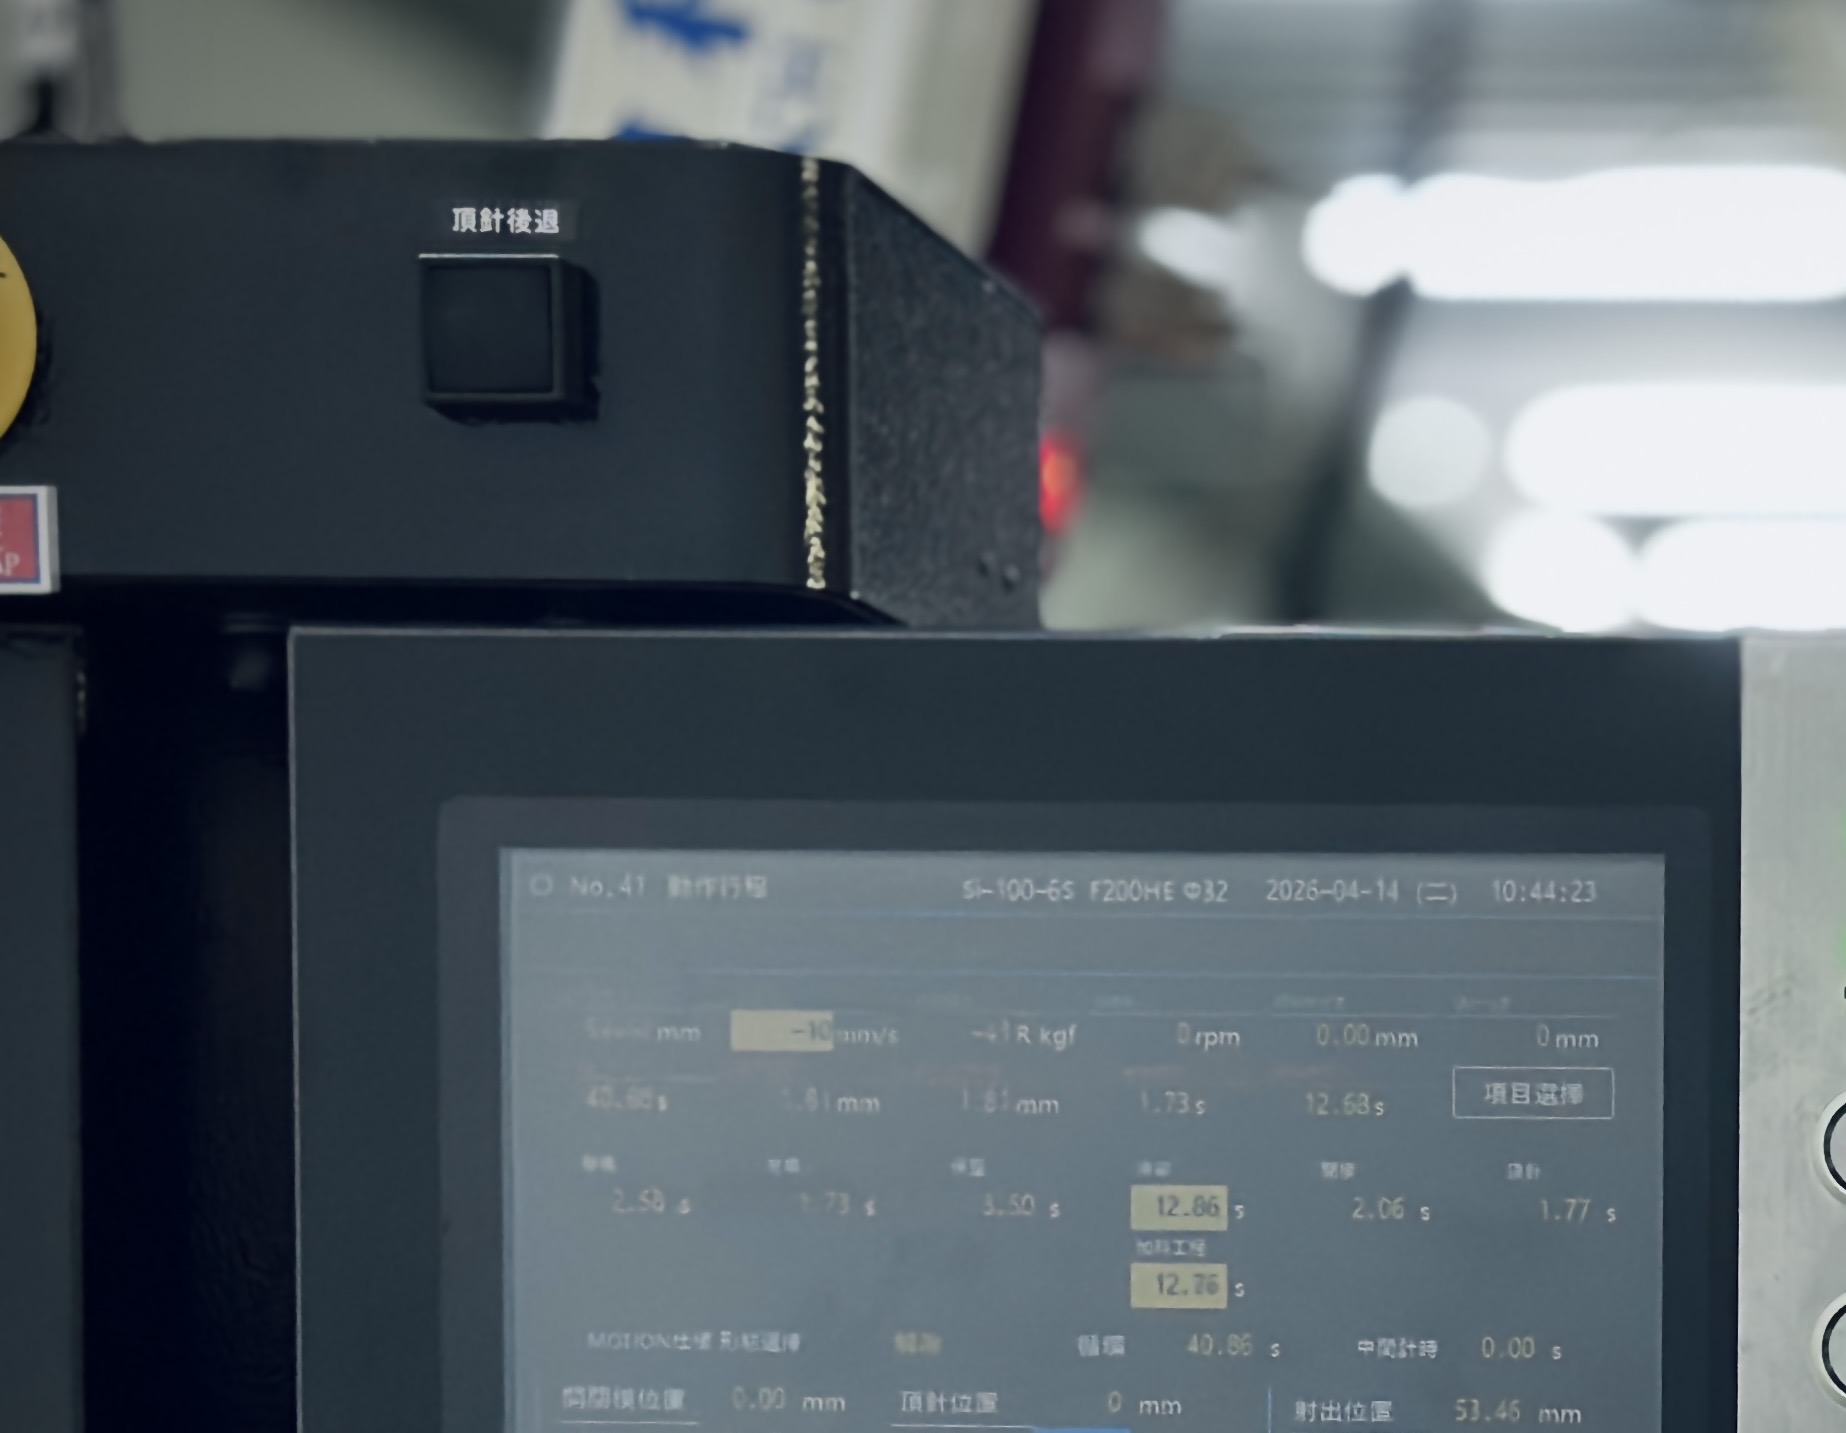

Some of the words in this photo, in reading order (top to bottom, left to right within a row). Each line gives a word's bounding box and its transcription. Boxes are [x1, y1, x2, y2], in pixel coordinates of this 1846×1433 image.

[452, 206, 560, 234] 頂針後退
[1089, 879, 1175, 902] F200HE
[1265, 879, 1399, 902] 2026-04-14
[1493, 879, 1599, 903] 10:44:23
[655, 1024, 701, 1042] mm
[1016, 1024, 1032, 1044] R
[1039, 1022, 1079, 1051] kgf
[1194, 1028, 1241, 1054] rpm
[1316, 1022, 1371, 1047] 0.00
[1374, 1030, 1419, 1048] mm
[1535, 1023, 1551, 1048] 0
[1554, 1031, 1600, 1049] mm
[836, 1095, 881, 1113] mm
[1015, 1098, 1060, 1115] mm
[1374, 1099, 1386, 1117] s
[1049, 1200, 1062, 1219] s
[1234, 1203, 1246, 1221] s
[1419, 1205, 1432, 1222] s
[1540, 1197, 1592, 1223] 1.77
[1606, 1206, 1618, 1224] s
[1234, 1282, 1246, 1299] s
[1270, 1341, 1281, 1359] s
[1480, 1334, 1537, 1361] 0.00
[1551, 1344, 1563, 1362] s
[801, 1395, 847, 1413] mm
[1138, 1398, 1183, 1416] mm
[1294, 1399, 1395, 1425] 射出位置
[1537, 1407, 1583, 1425] mm
